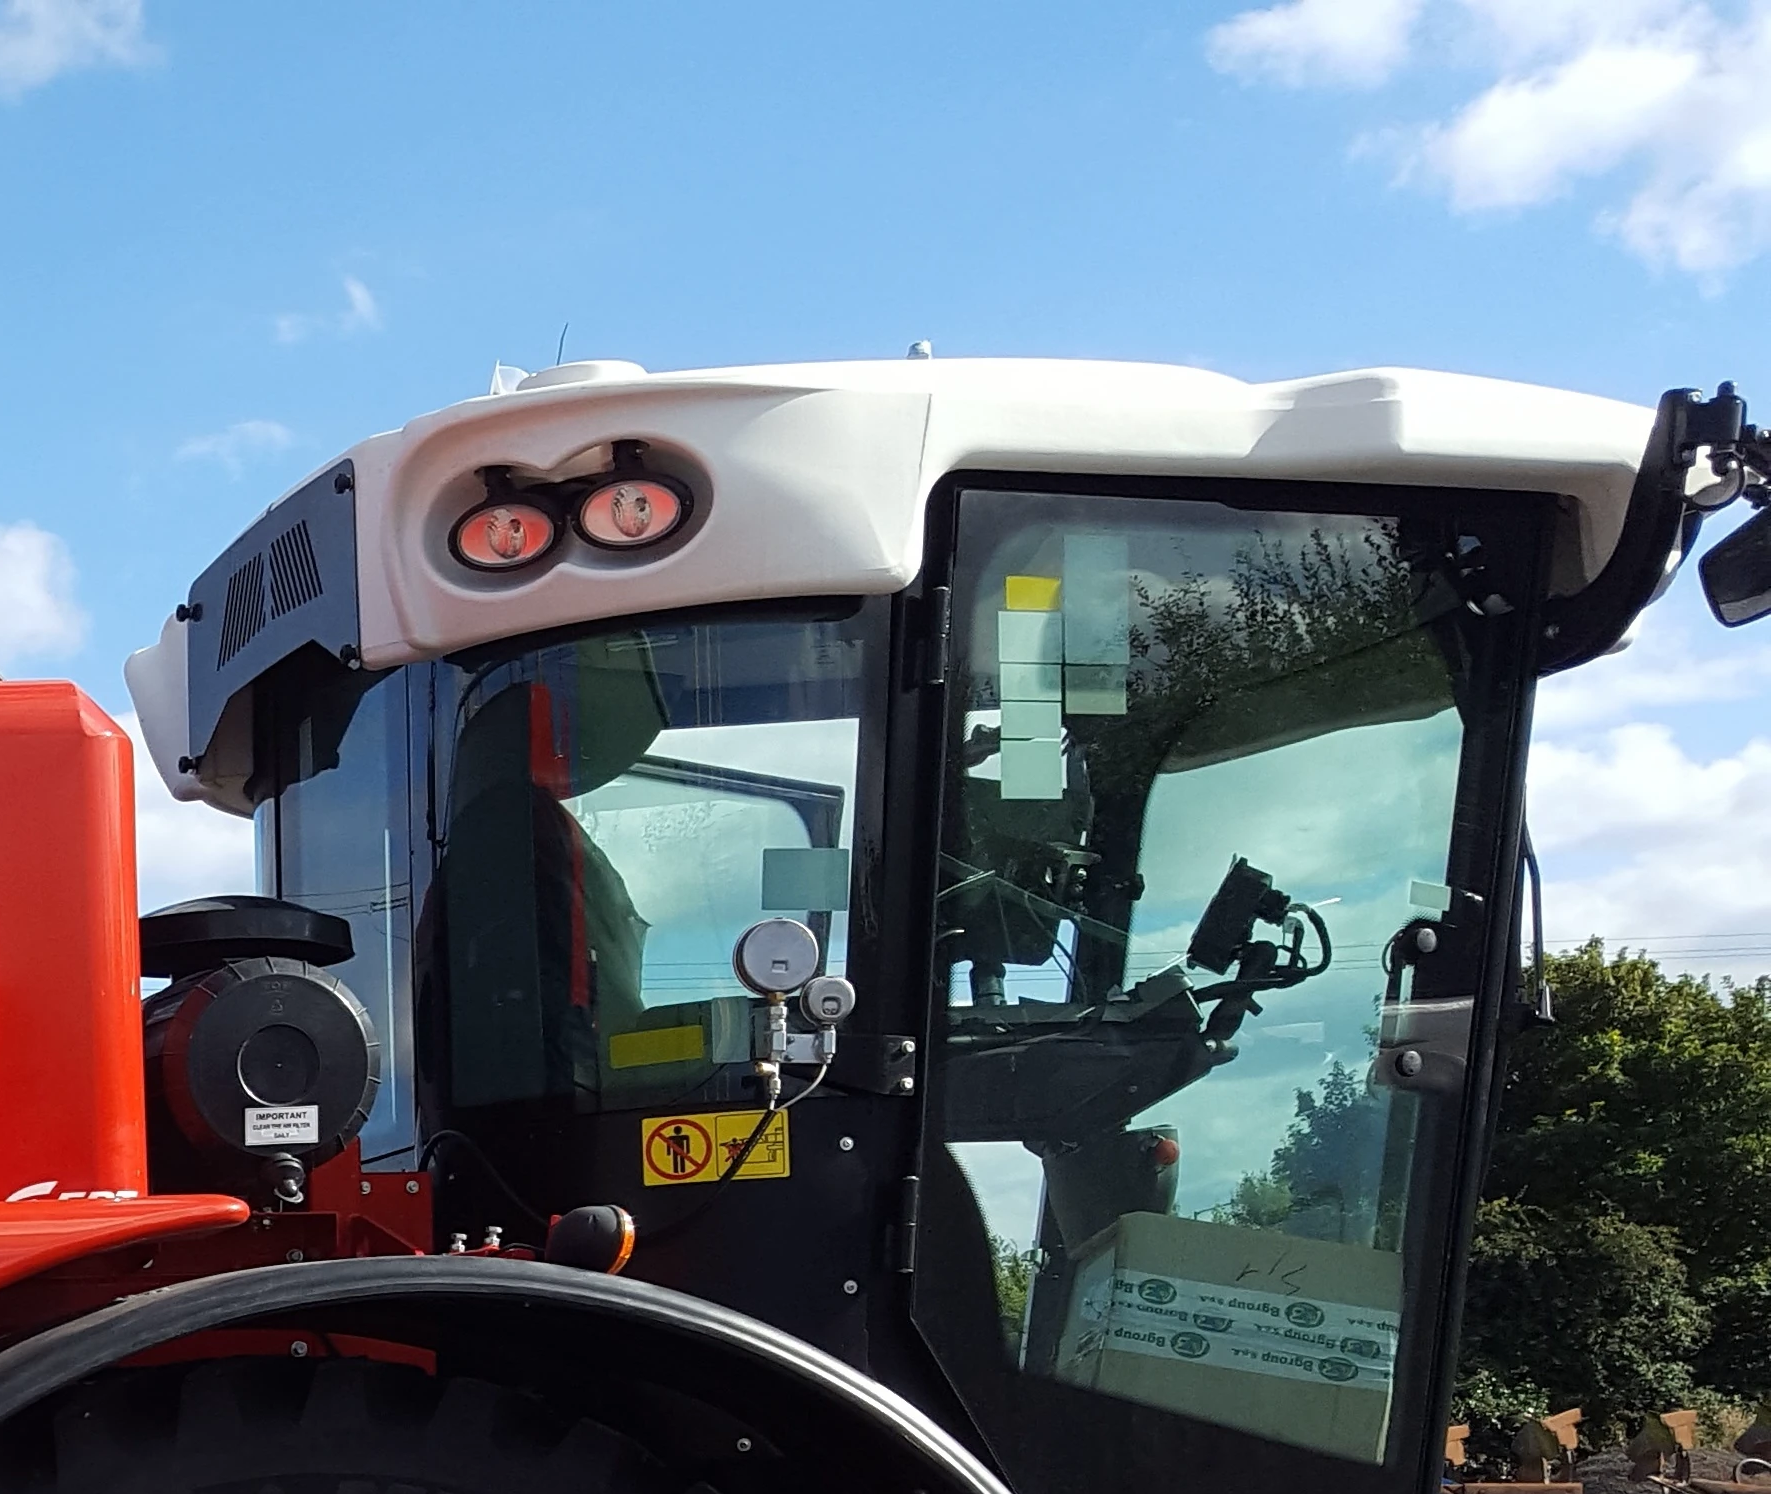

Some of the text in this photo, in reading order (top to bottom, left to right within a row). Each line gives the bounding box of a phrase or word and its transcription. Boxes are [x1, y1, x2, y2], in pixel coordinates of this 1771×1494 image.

[256, 1111, 308, 1121] IMPORTANT
[1228, 1298, 1280, 1317] Bgroup
[1114, 1326, 1166, 1347] Bgroup
